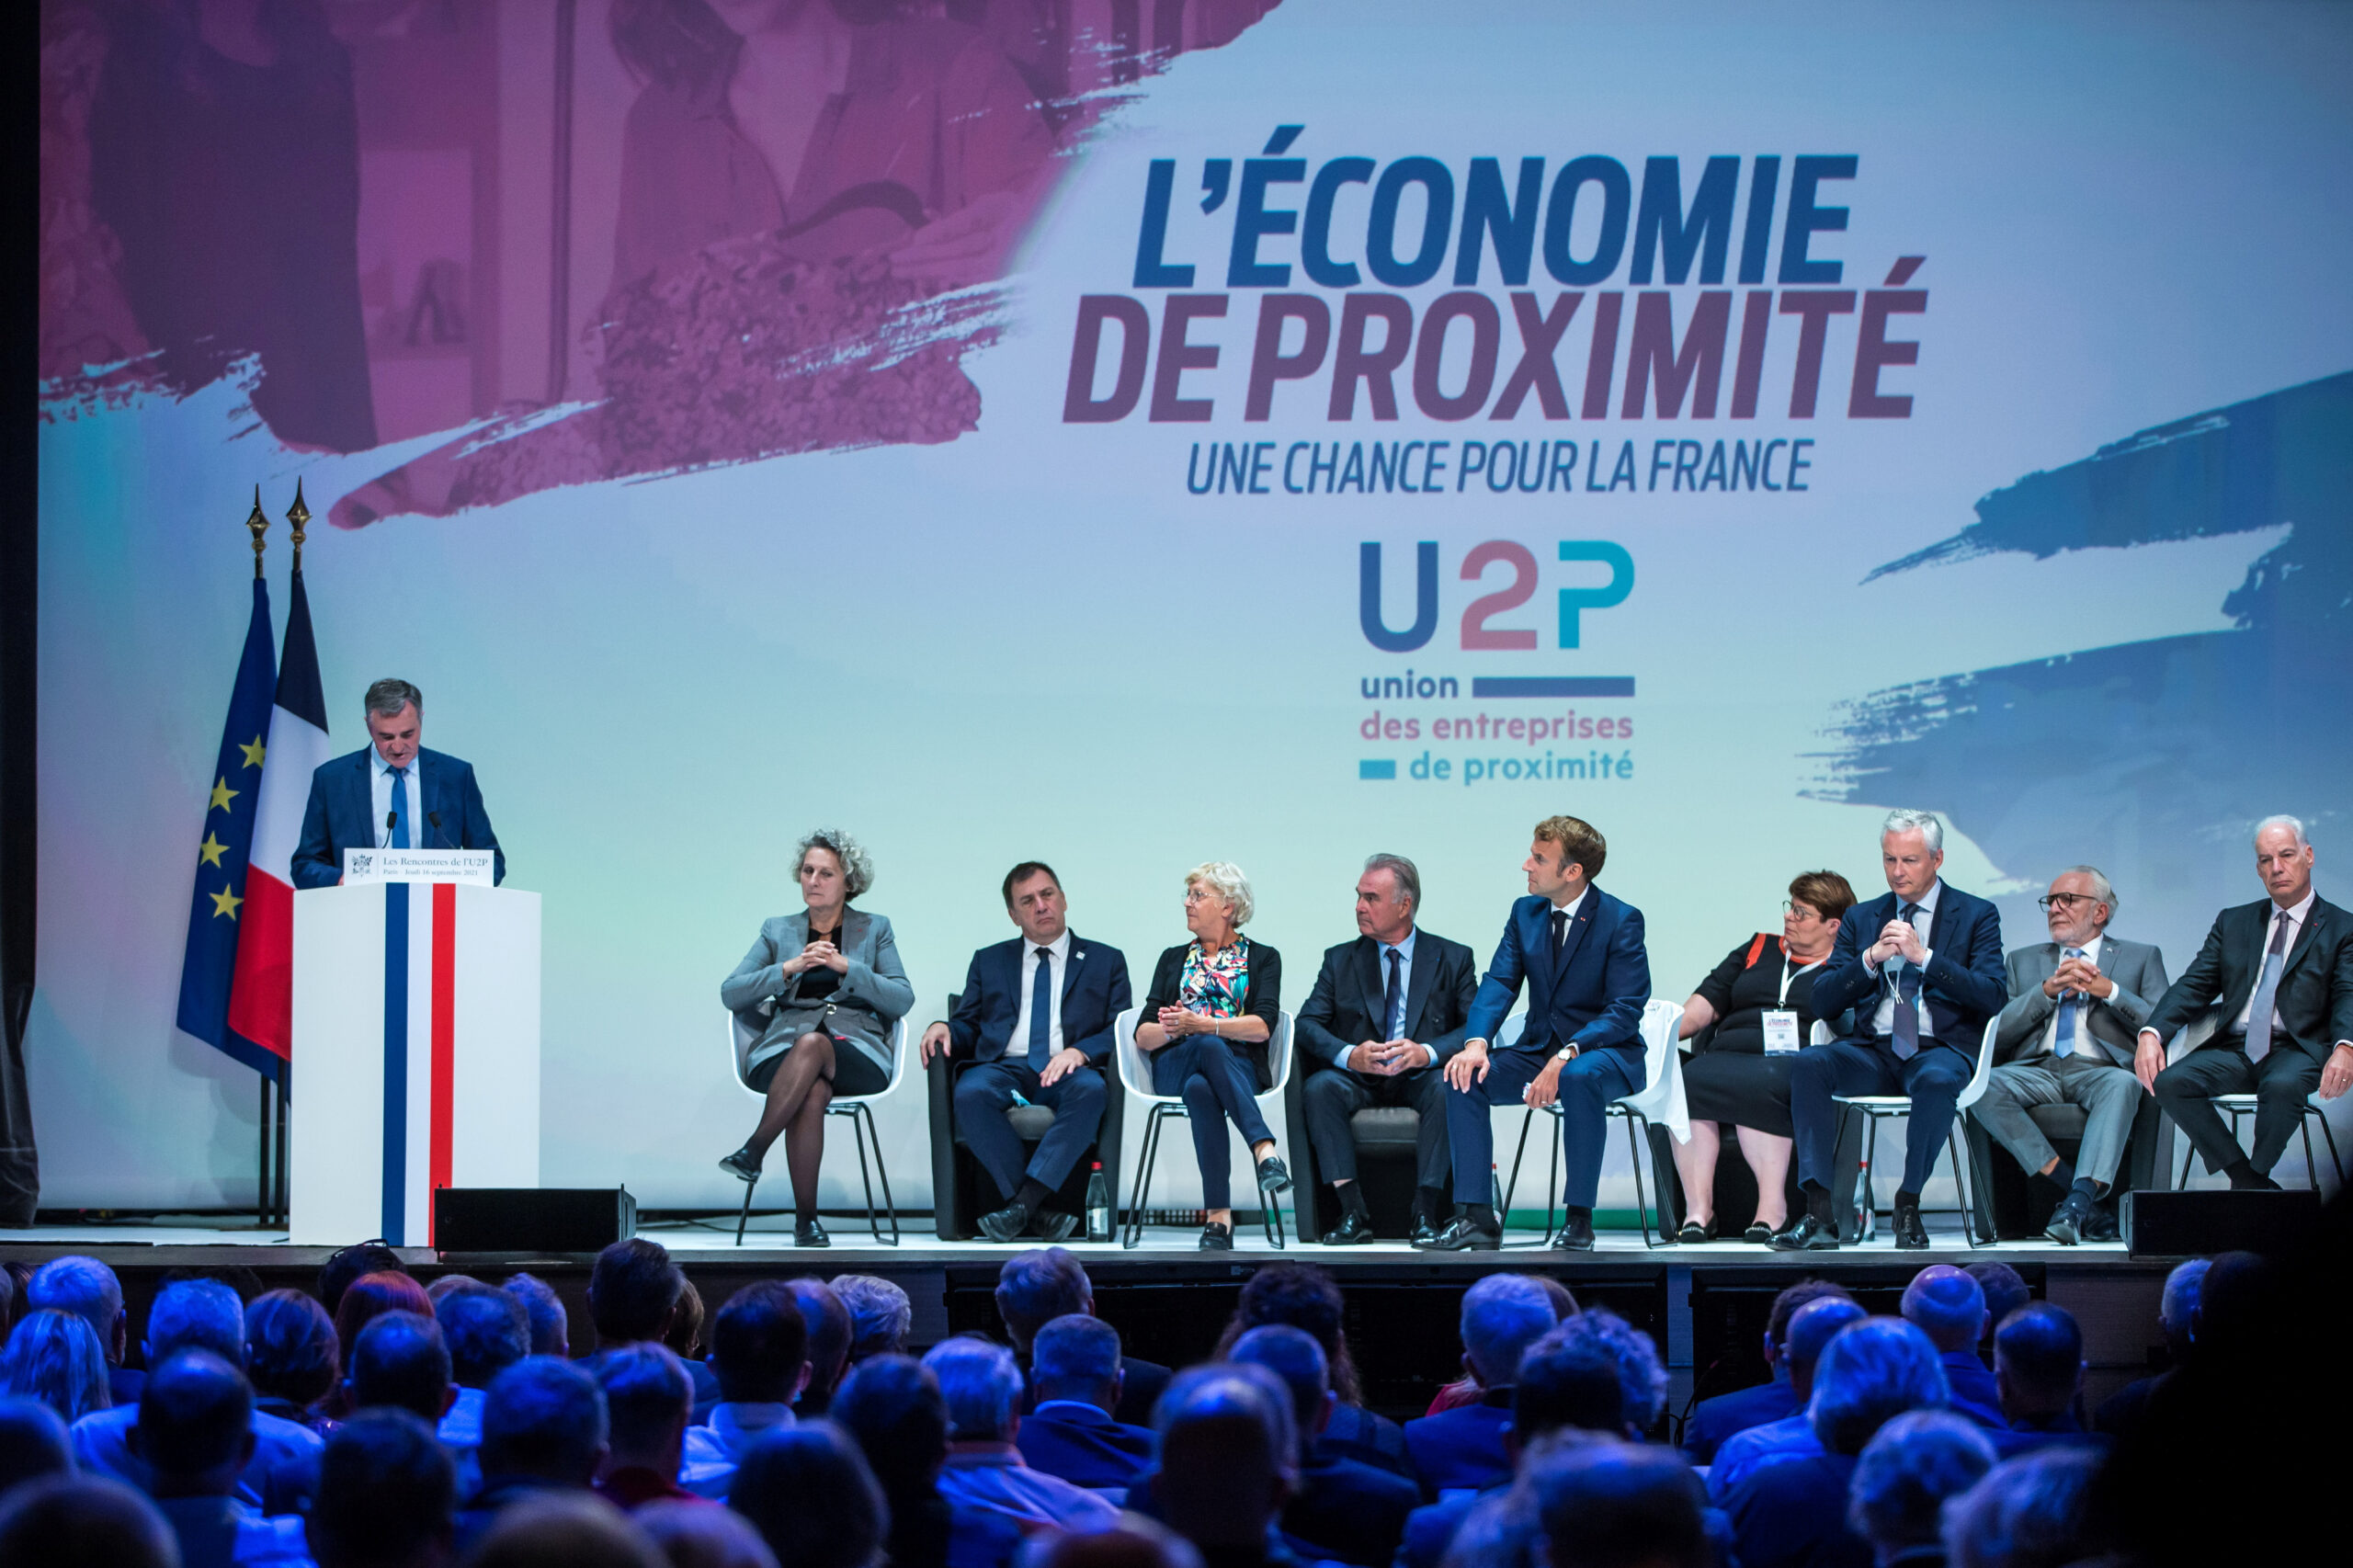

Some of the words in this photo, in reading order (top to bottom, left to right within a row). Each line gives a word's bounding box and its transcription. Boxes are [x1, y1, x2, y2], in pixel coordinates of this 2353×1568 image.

[1132, 125, 1859, 289] L'ÉCONOMIE
[1063, 294, 1229, 423] DE
[1245, 256, 1928, 422] PROXIMITÉ
[1187, 442, 1276, 494] UNE
[1283, 441, 1449, 494] CHANCE
[1457, 440, 1578, 493] POUR
[1586, 439, 1636, 492] LA
[1649, 438, 1814, 492] FRANCE
[1359, 540, 1635, 653] U2P
[1361, 669, 1459, 699] union
[1359, 710, 1420, 740] des
[1432, 710, 1633, 746] entreprises
[1410, 751, 1451, 780] de
[1464, 749, 1633, 786] proximité
[383, 857, 398, 866] Les
[401, 857, 449, 866] Rencontres
[450, 858, 461, 866] de
[463, 858, 488, 867] l'U2P
